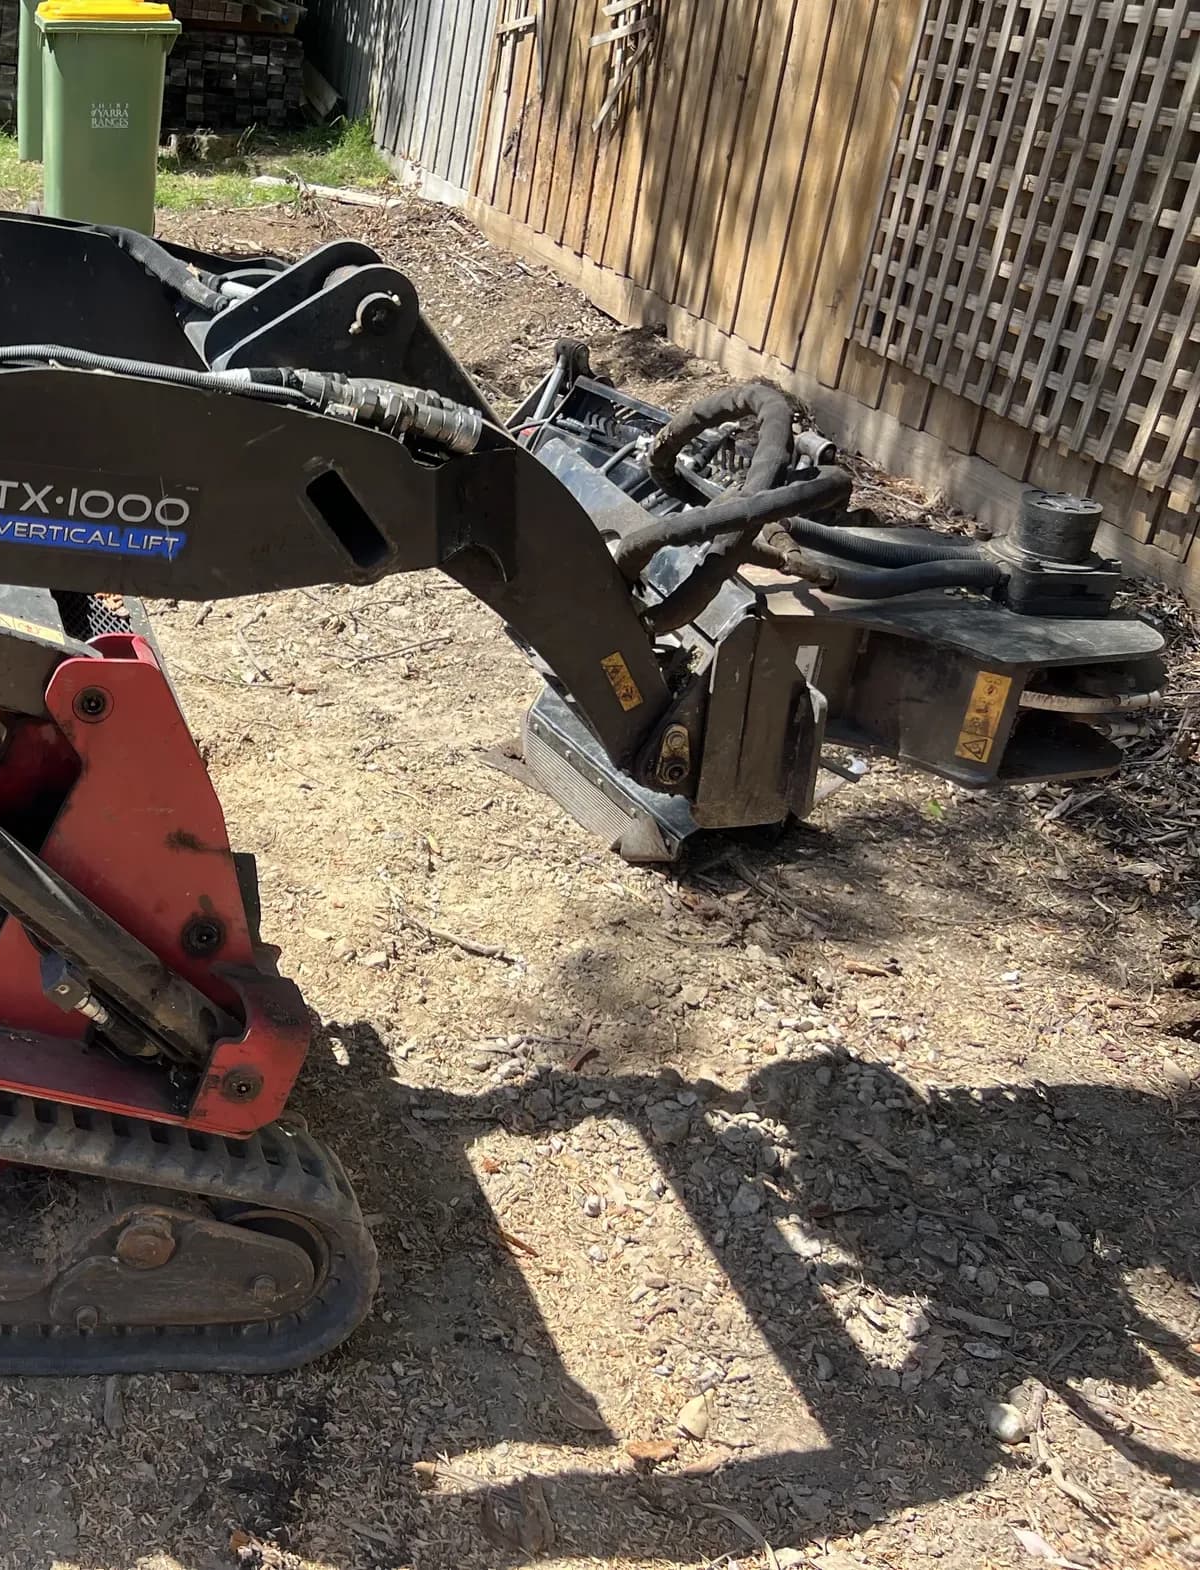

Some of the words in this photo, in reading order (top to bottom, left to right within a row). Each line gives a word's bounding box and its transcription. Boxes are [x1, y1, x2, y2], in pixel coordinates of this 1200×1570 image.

[97, 109, 129, 118] YARRA
[91, 118, 129, 128] RANGES
[128, 532, 179, 553] LIFT
